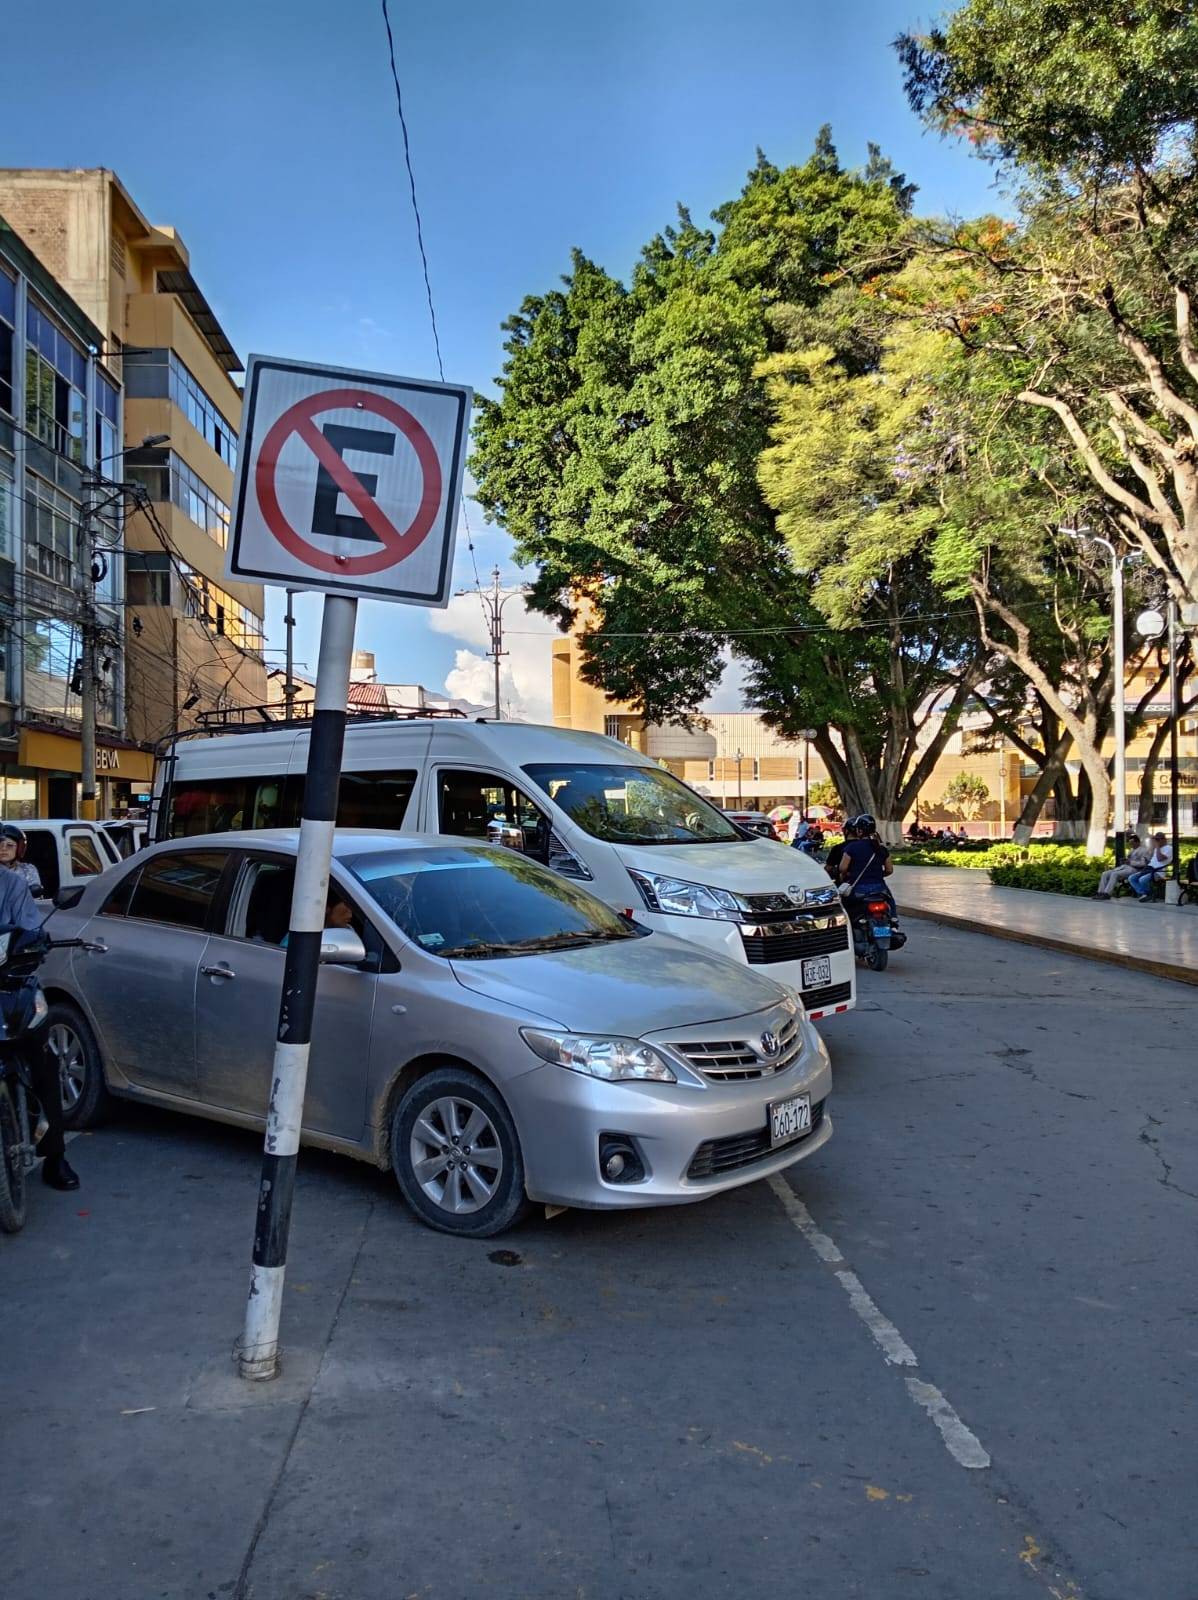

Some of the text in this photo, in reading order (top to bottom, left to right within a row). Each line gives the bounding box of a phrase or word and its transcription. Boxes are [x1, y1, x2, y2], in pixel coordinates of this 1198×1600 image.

[311, 423, 397, 543] E
[96, 748, 120, 769] BBVA
[773, 1104, 809, 1138] C60-172
